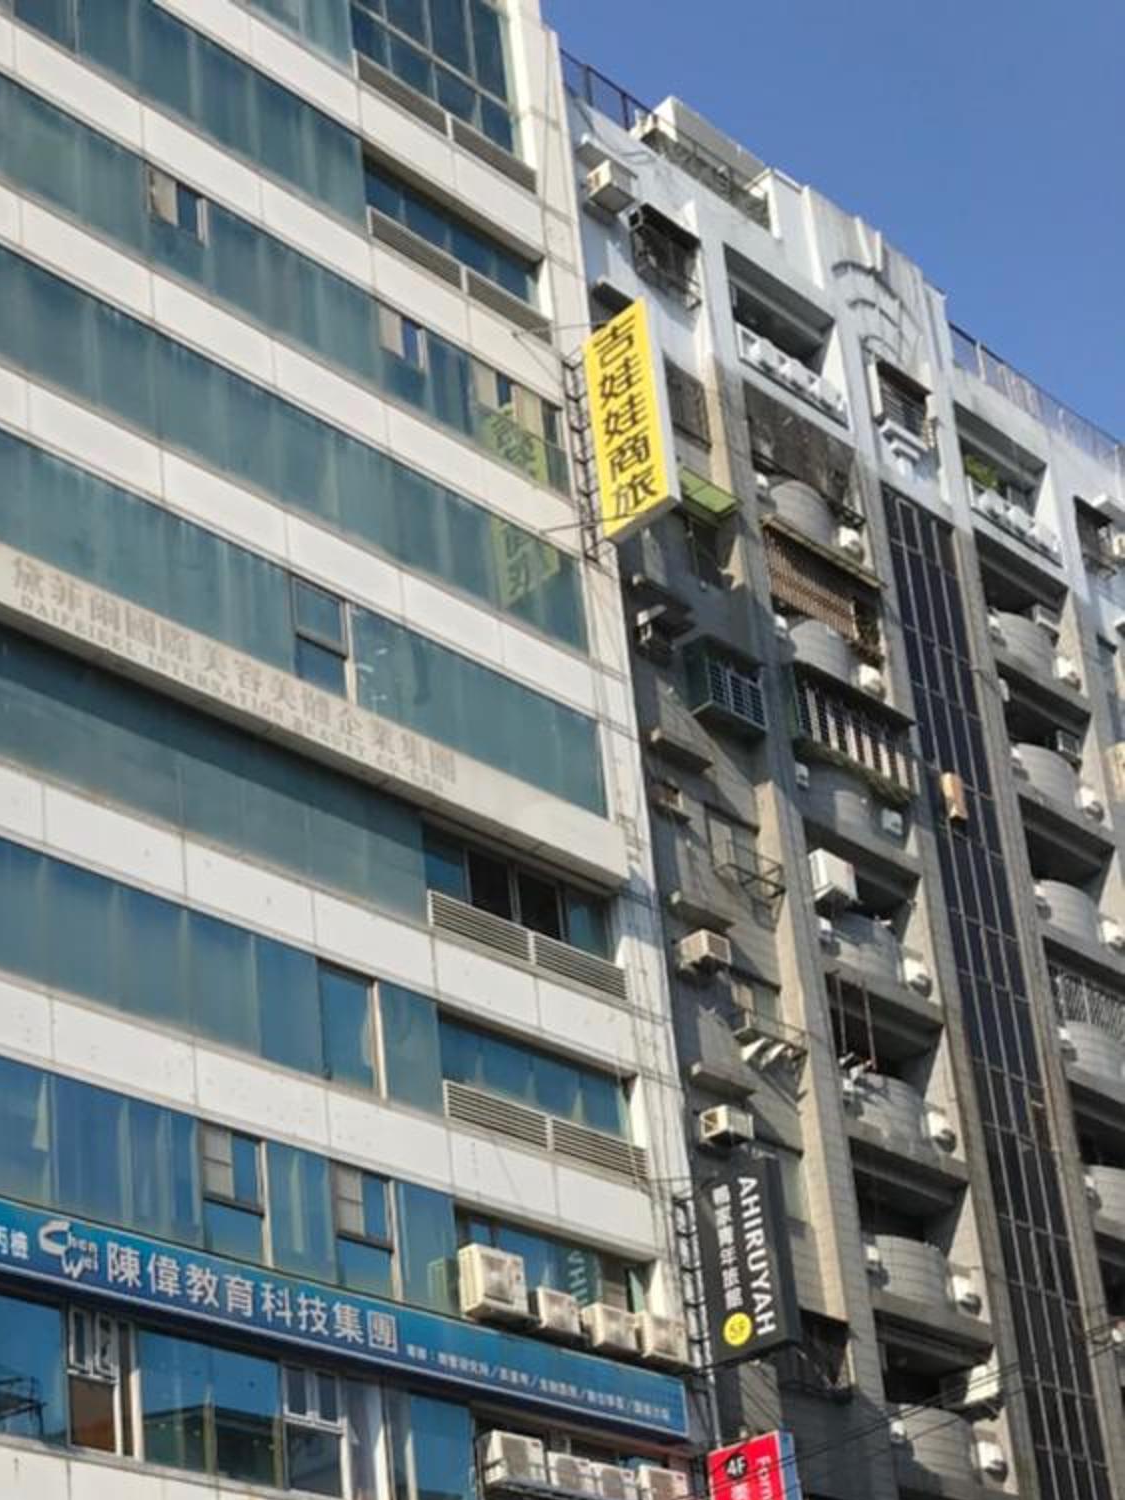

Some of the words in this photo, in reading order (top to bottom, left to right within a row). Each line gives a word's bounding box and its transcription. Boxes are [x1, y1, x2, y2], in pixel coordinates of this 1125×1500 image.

[593, 313, 658, 520] 吉娃娃商旅
[107, 1241, 399, 1355] 陳偉教育科技集團
[737, 1176, 777, 1336] AHIRUYAH
[727, 1456, 747, 1477] 4F
